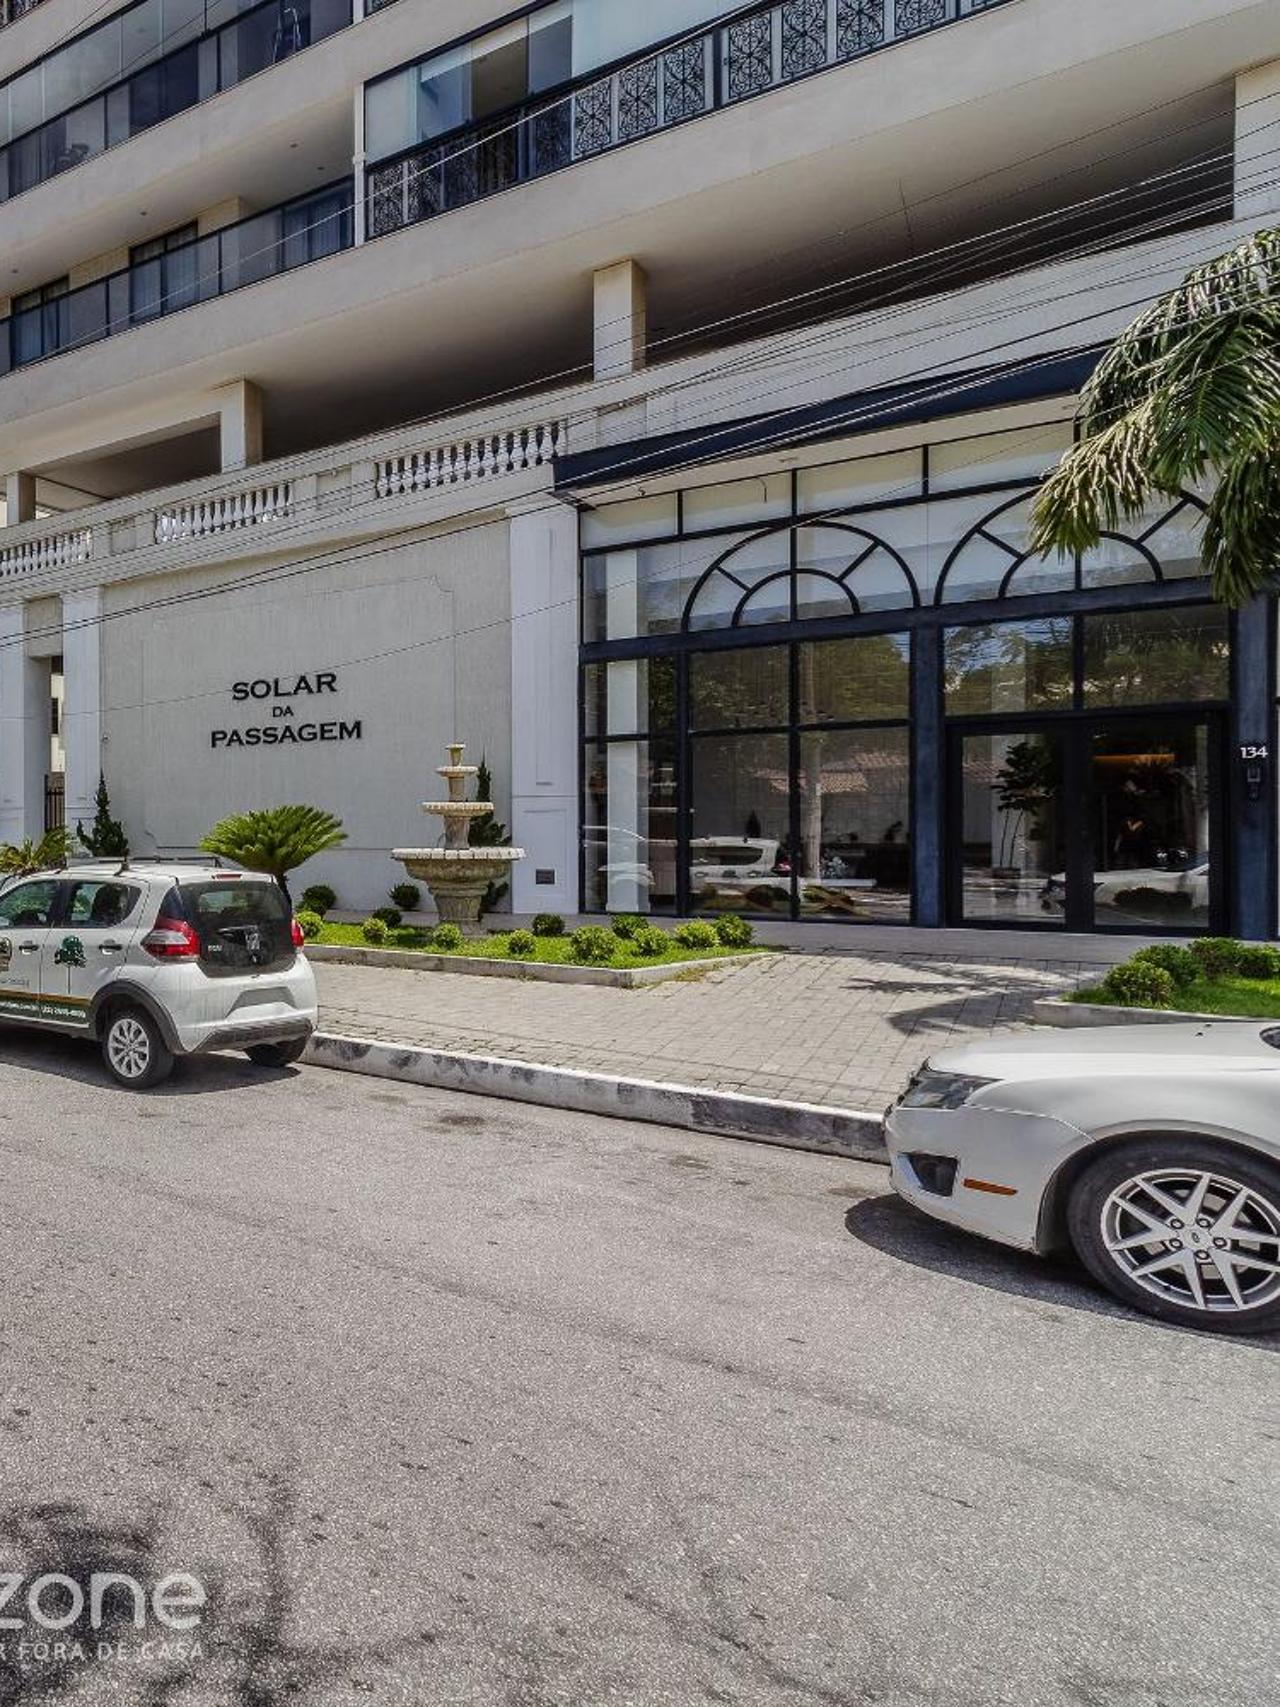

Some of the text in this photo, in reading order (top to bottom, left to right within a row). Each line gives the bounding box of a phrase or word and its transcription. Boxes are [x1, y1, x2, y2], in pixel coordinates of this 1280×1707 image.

[232, 673, 337, 701] SOLAR
[272, 705, 294, 718] DA
[210, 720, 362, 748] PASSAGEM
[1240, 746, 1269, 758] 134
